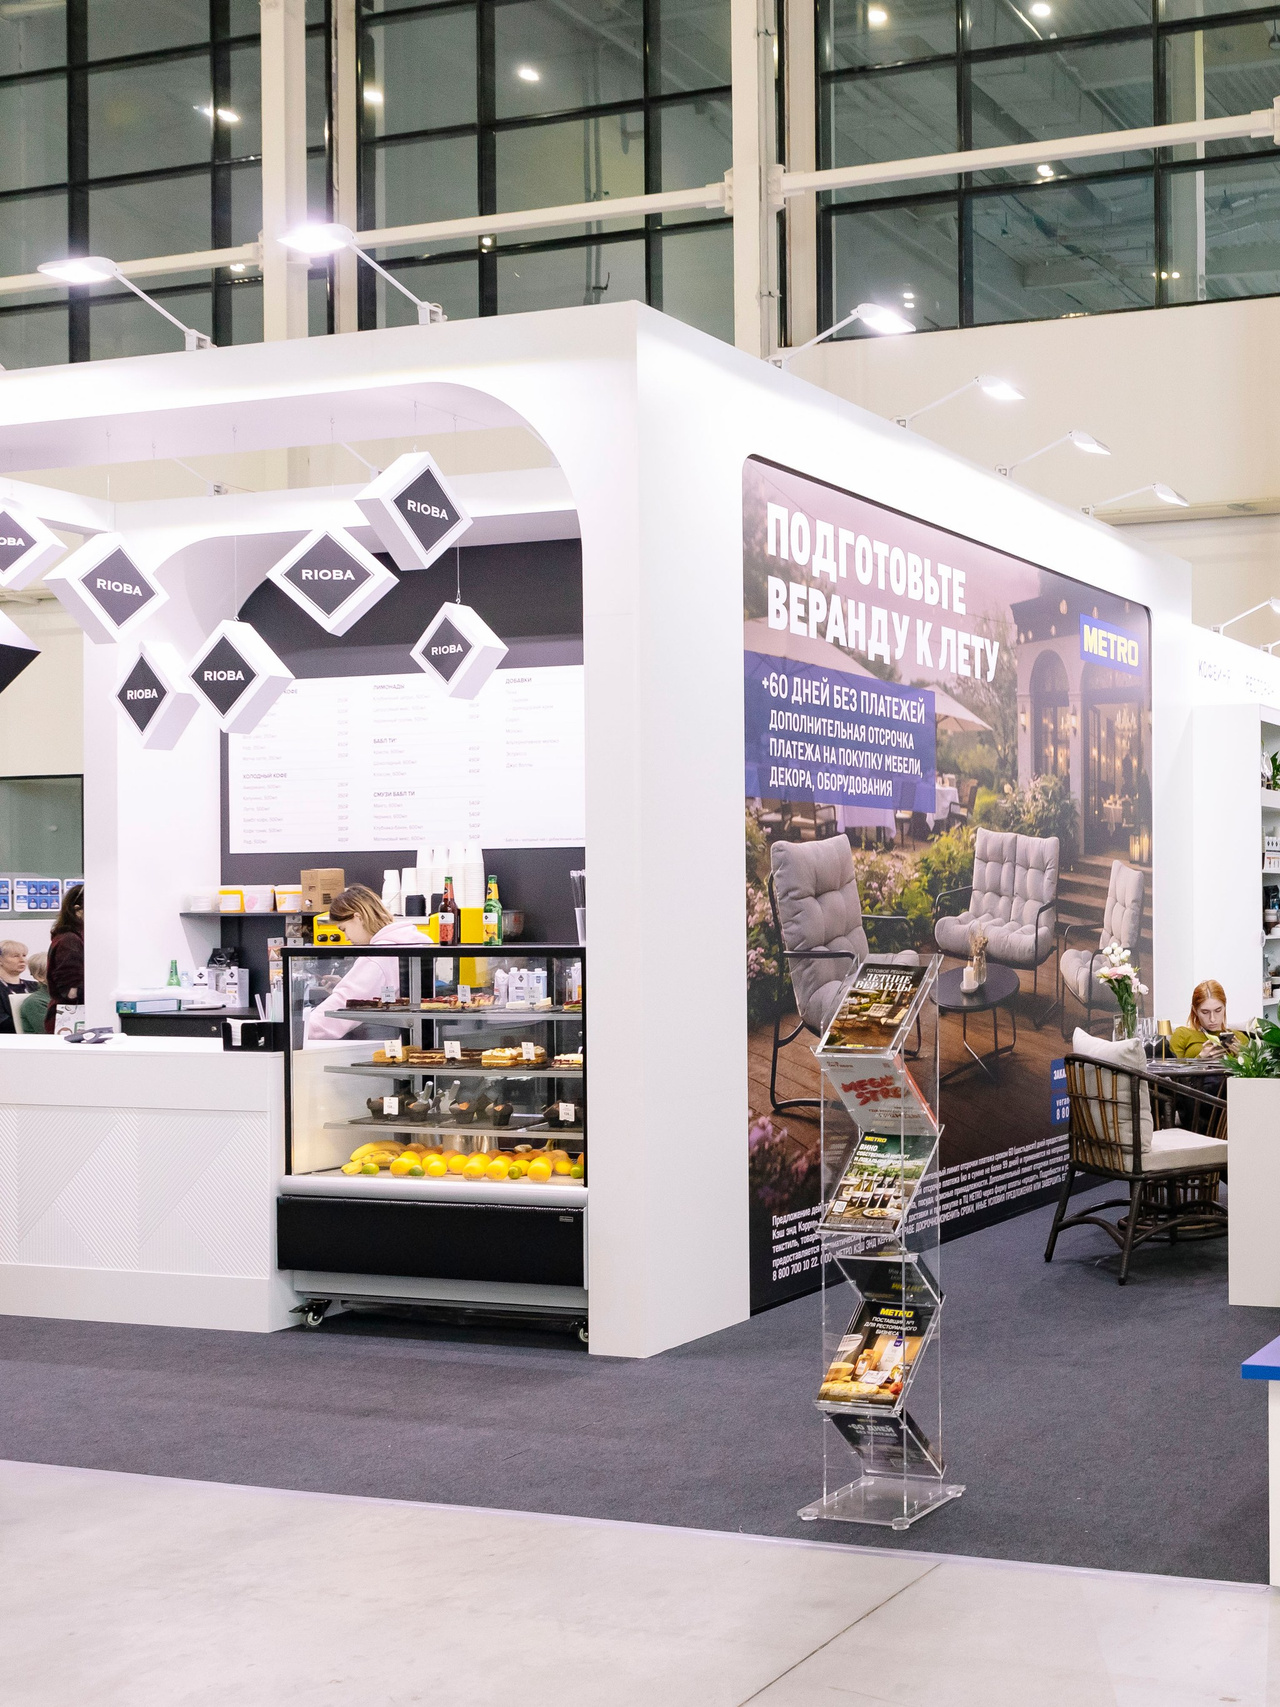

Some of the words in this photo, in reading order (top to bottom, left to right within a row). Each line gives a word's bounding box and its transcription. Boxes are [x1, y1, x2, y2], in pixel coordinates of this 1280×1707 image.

[407, 498, 449, 521] RIOBA
[767, 502, 966, 616] ПОДГОТОВЬТЕ
[301, 568, 355, 581] RIOBA
[96, 577, 142, 597] RIOBA
[767, 575, 911, 665] ВЕРАНДУ
[916, 618, 937, 669] К
[938, 626, 1000, 683] ЛЕТУ
[431, 643, 463, 655] RIOBA
[1083, 623, 1139, 668] METRO
[203, 669, 245, 681] RIOBA
[126, 688, 159, 701] RIOBA
[761, 671, 789, 700] +60
[791, 676, 830, 710] ДНЕЙ
[833, 683, 858, 713] БЕЗ
[860, 689, 926, 725] ПЛАТЕЖЕЙ
[769, 709, 867, 743] ДОПОЛНИТЕЛЬНАЯ
[868, 725, 914, 750] ОТСРОЧКА
[769, 738, 821, 765] ПЛАТЕЖА
[823, 747, 837, 765] НА
[839, 750, 883, 771] ПОКУПКУ
[885, 757, 924, 779] МЕБЕЛИ,
[243, 772, 272, 780] ХОЛОДНЫЙ
[769, 766, 815, 793] ДЕКОРА,
[817, 773, 893, 798] ОБОРУДОВАНИЯ
[855, 981, 913, 992] ВЕРАНДЫ
[863, 973, 913, 984] ЛЕТНИЕ
[858, 1144, 878, 1152] ВИНО
[772, 1209, 811, 1227] Предложение
[772, 1228, 785, 1240] Кэш
[785, 1225, 798, 1237] энд
[772, 1245, 820, 1268] предоставляется
[772, 1270, 777, 1281] 8
[778, 1265, 790, 1279] 800
[791, 1262, 802, 1275] 700
[802, 1260, 810, 1271] 10
[879, 1308, 915, 1318] METRO
